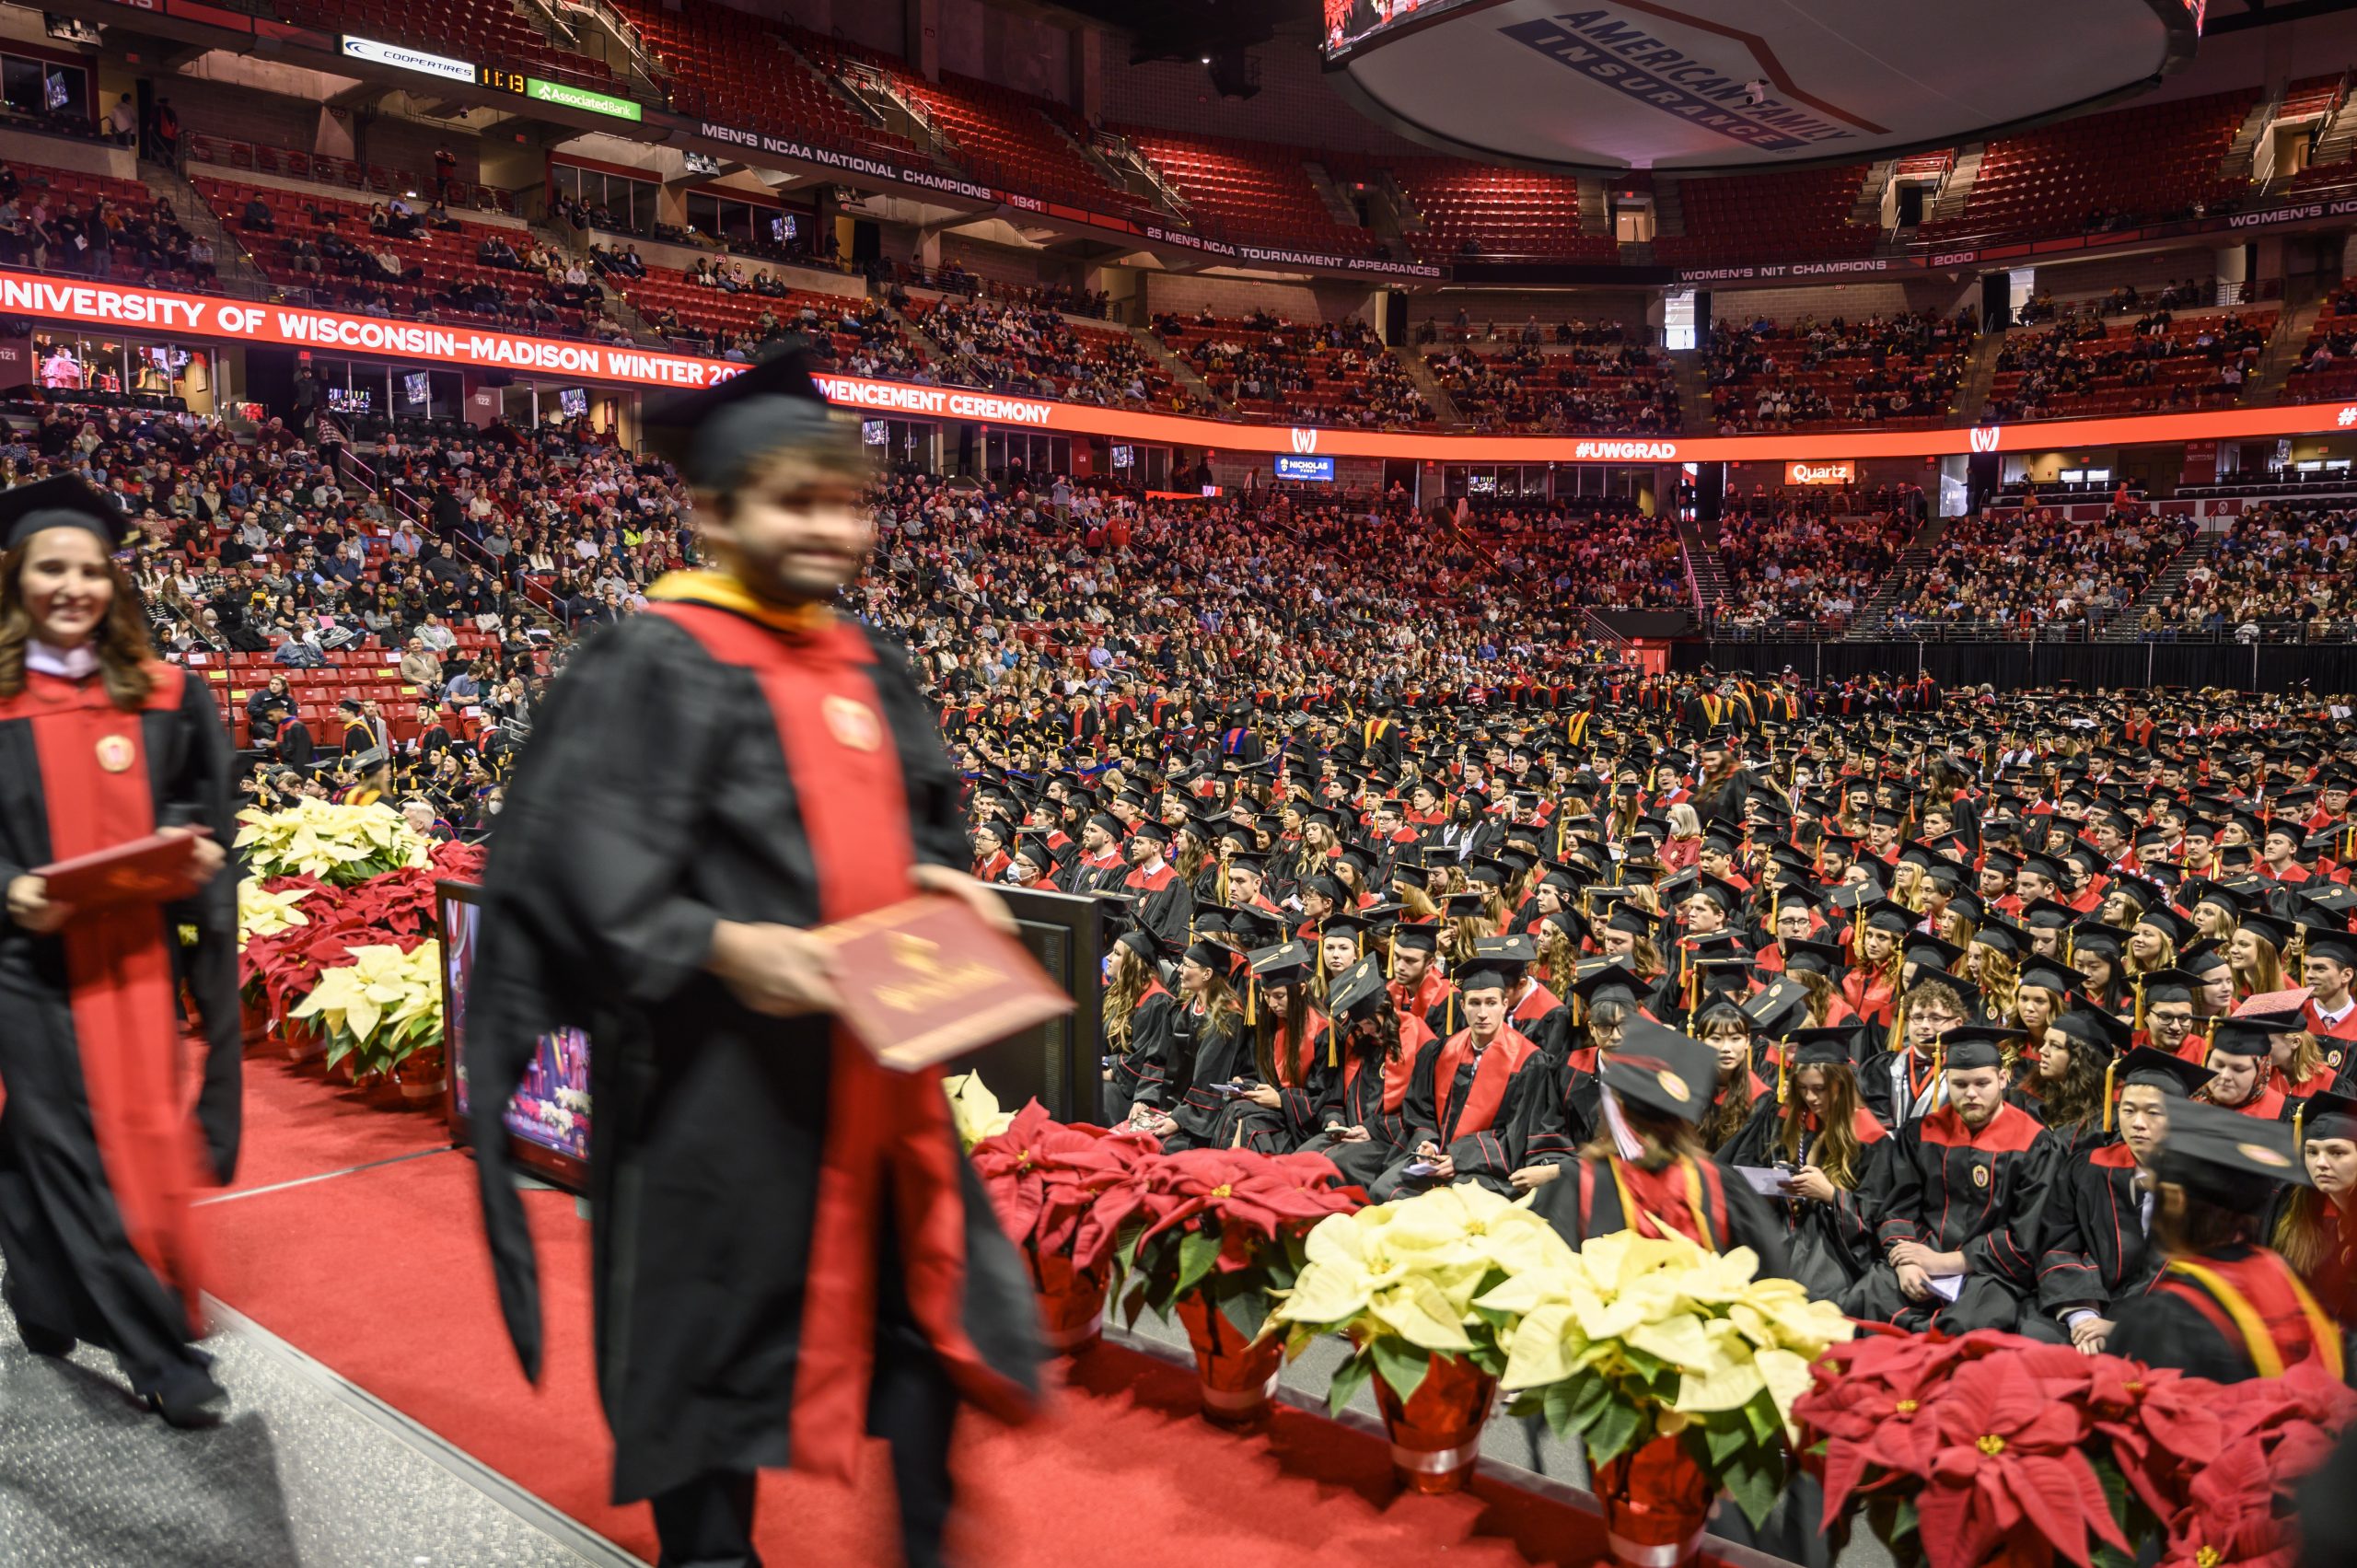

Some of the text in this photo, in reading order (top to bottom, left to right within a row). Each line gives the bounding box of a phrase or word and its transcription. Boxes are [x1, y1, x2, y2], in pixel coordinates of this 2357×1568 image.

[483, 67, 524, 93] 11:13
[1553, 10, 1857, 143] AMERICAN FAMILY
[1535, 35, 1785, 145] INSURANCE
[702, 122, 992, 200] MEN'S NCAA NATIONAL CHAMPIONS
[1011, 194, 1042, 212] 1941
[2230, 205, 2322, 227] WOMEN'S
[715, 255, 726, 263] 223
[1147, 226, 1441, 277] 25 MEN'S NCAA TOURNAMENT APPEARANCES
[1933, 251, 1975, 266] 2000
[1681, 260, 1887, 281] WOMEN'S NIT CHAMPIONS
[217, 306, 265, 334] OF
[608, 353, 703, 385] WINTER
[811, 378, 946, 412] MENCEMENT
[949, 395, 1051, 424] CEREMONY
[478, 397, 490, 406] 122
[1575, 442, 1677, 459] #UWGRAD
[1289, 460, 1329, 470] NICHOLAS
[1793, 464, 1847, 482] Quartz
